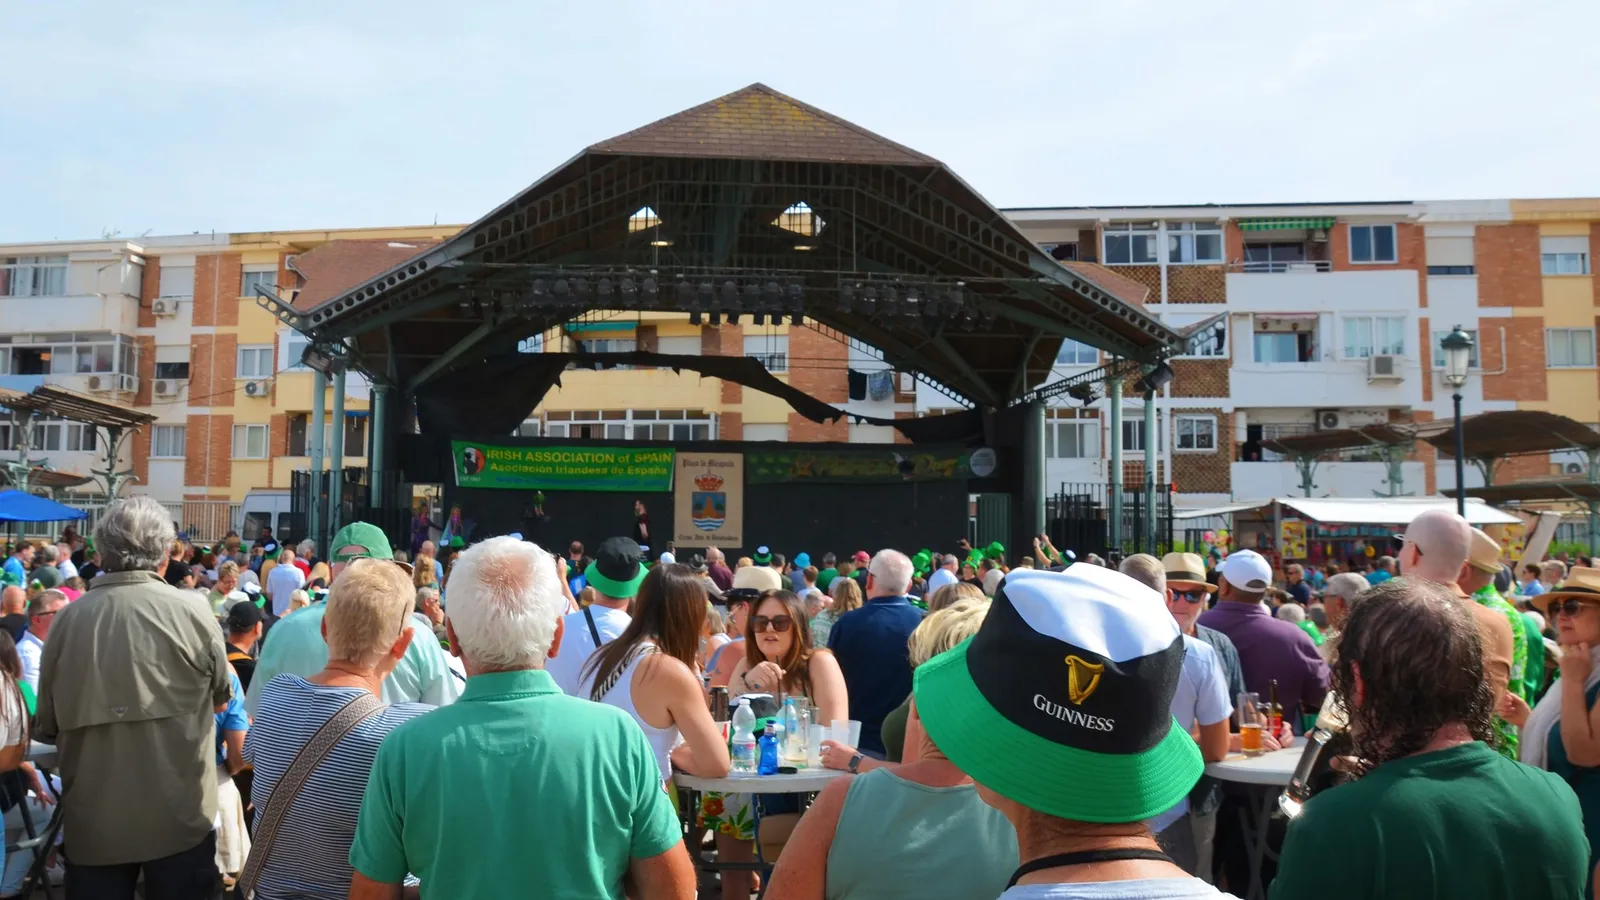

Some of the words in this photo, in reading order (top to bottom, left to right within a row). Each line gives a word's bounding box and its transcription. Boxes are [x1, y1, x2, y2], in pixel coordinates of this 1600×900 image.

[486, 449, 522, 461] IRISH
[525, 451, 615, 464] ASSOCIATION
[618, 453, 630, 464] of
[635, 452, 672, 464] SPAIN
[555, 465, 608, 475] Irlandesa
[611, 465, 624, 475] de
[627, 466, 668, 476] España
[1033, 693, 1115, 732] GUINNESS
